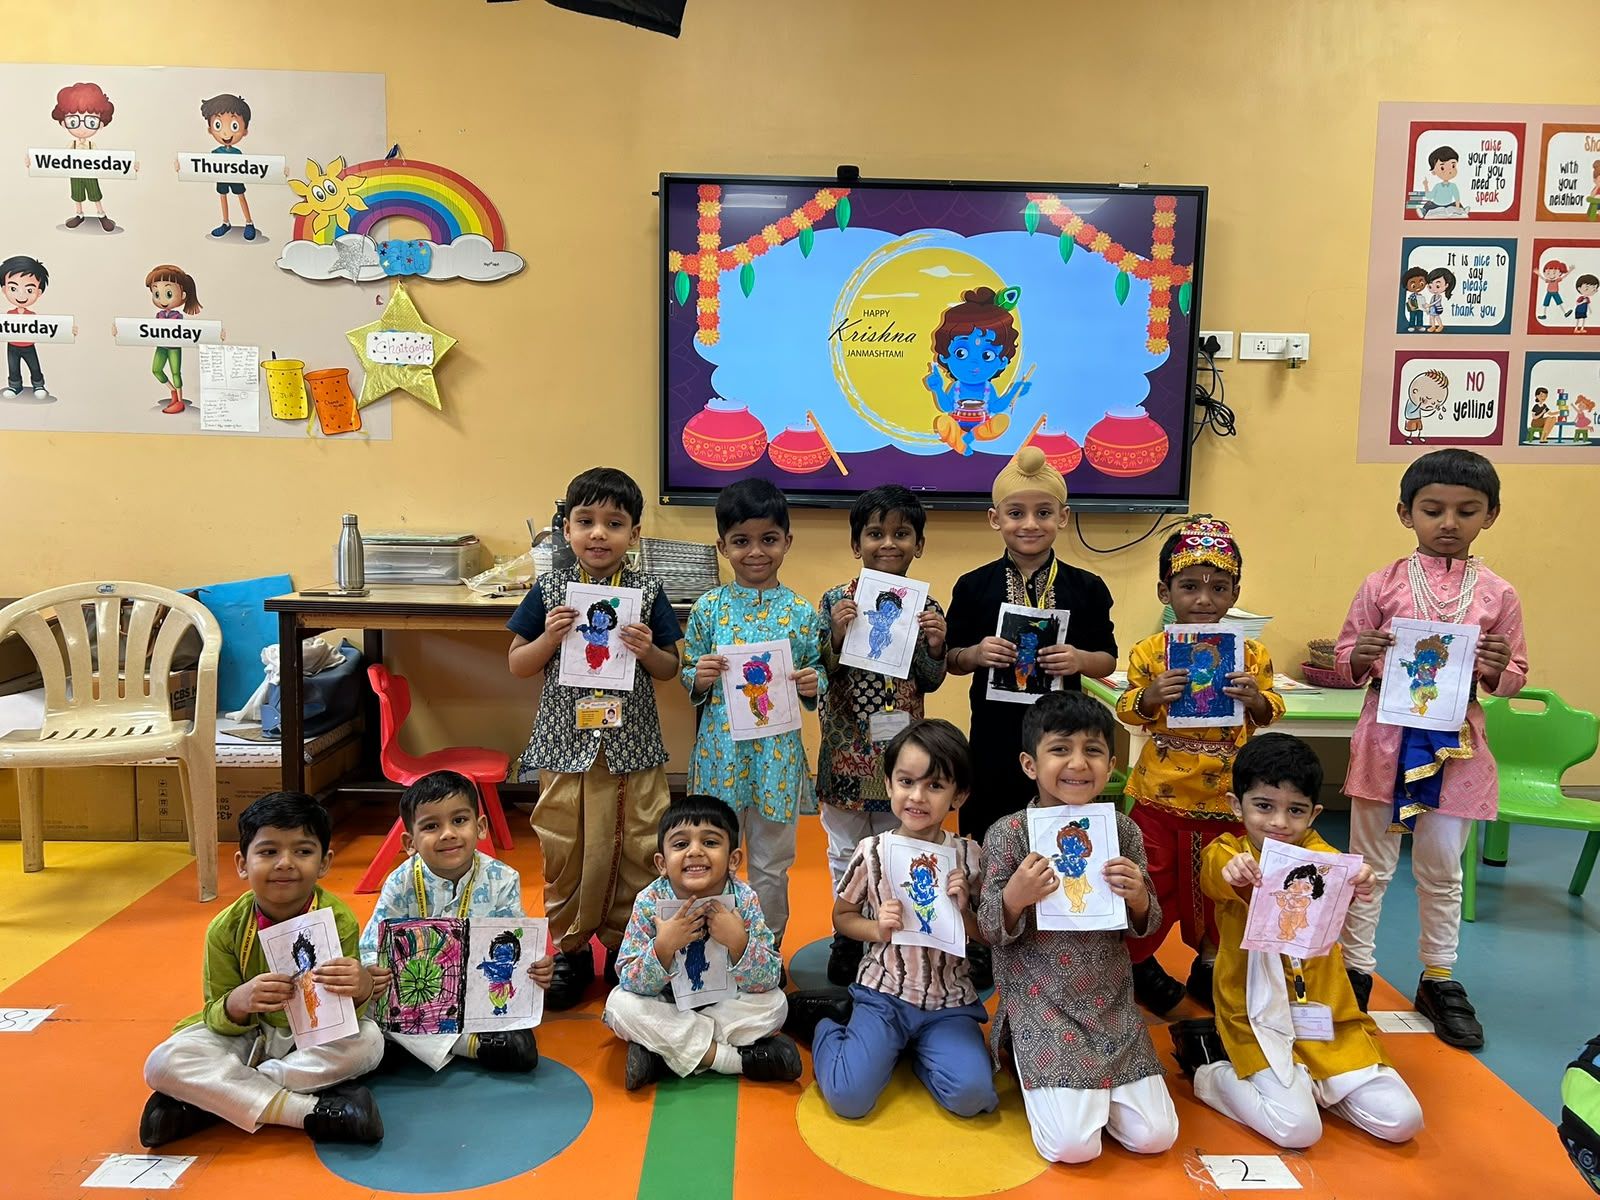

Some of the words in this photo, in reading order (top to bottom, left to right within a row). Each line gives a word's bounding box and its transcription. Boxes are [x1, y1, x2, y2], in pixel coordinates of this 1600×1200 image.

[1481, 139, 1502, 151] raise
[35, 154, 132, 174] Wednesday
[1468, 152, 1488, 166] your
[1493, 150, 1513, 165] hand
[190, 158, 269, 179] Thursday
[1487, 165, 1504, 179] you
[1560, 160, 1579, 174] with
[1471, 178, 1490, 190] need
[1496, 177, 1506, 190] to
[1558, 178, 1578, 192] your
[1476, 190, 1499, 206] speak
[1549, 192, 1585, 207] neighbor
[1447, 252, 1456, 266] It
[1461, 254, 1469, 266] is
[1473, 253, 1491, 267] nice
[1496, 253, 1507, 267] to
[1468, 267, 1484, 281] say
[1463, 279, 1488, 294] please
[1467, 292, 1482, 304] and
[863, 309, 891, 318] HAPPY
[1451, 303, 1475, 317] thank
[1480, 305, 1497, 319] you
[139, 323, 202, 343] Sunday
[828, 318, 917, 343] Krishna
[846, 349, 904, 358] JANMASHTAMI
[1466, 371, 1485, 392] NO
[1453, 399, 1494, 421] yelling
[130, 1158, 163, 1184] 7
[1231, 1158, 1267, 1182] 2
